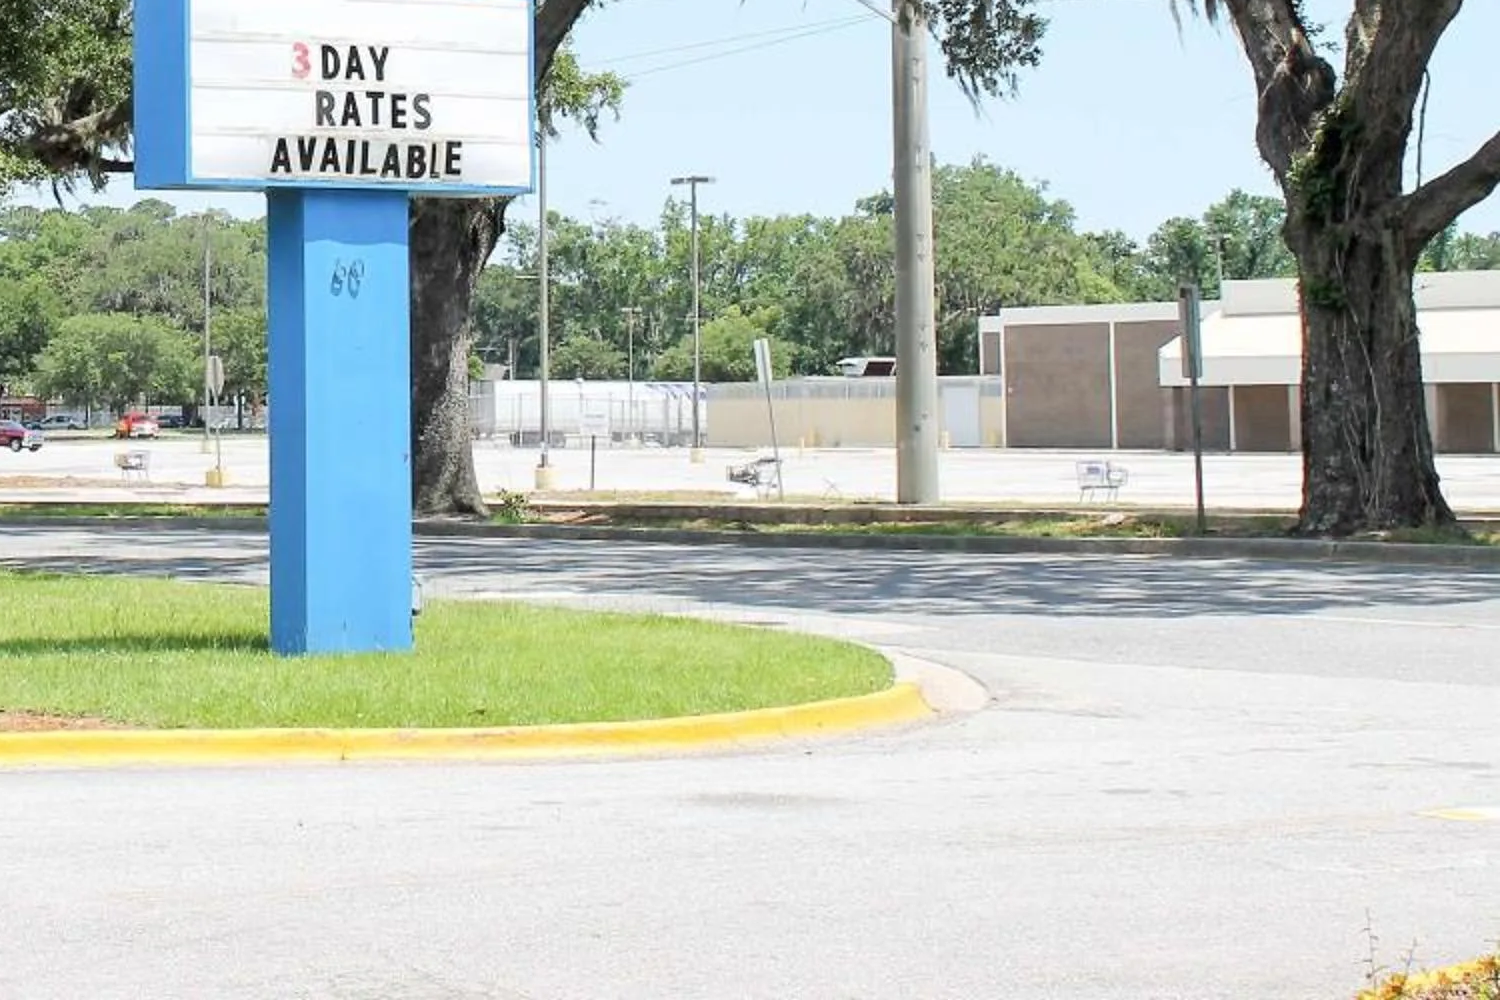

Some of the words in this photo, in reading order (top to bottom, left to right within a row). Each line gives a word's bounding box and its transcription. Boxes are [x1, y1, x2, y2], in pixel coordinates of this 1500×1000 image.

[291, 41, 311, 80] 3
[321, 43, 389, 81] DAY
[315, 90, 433, 130] RATES
[270, 135, 463, 179] AVAILABLE
